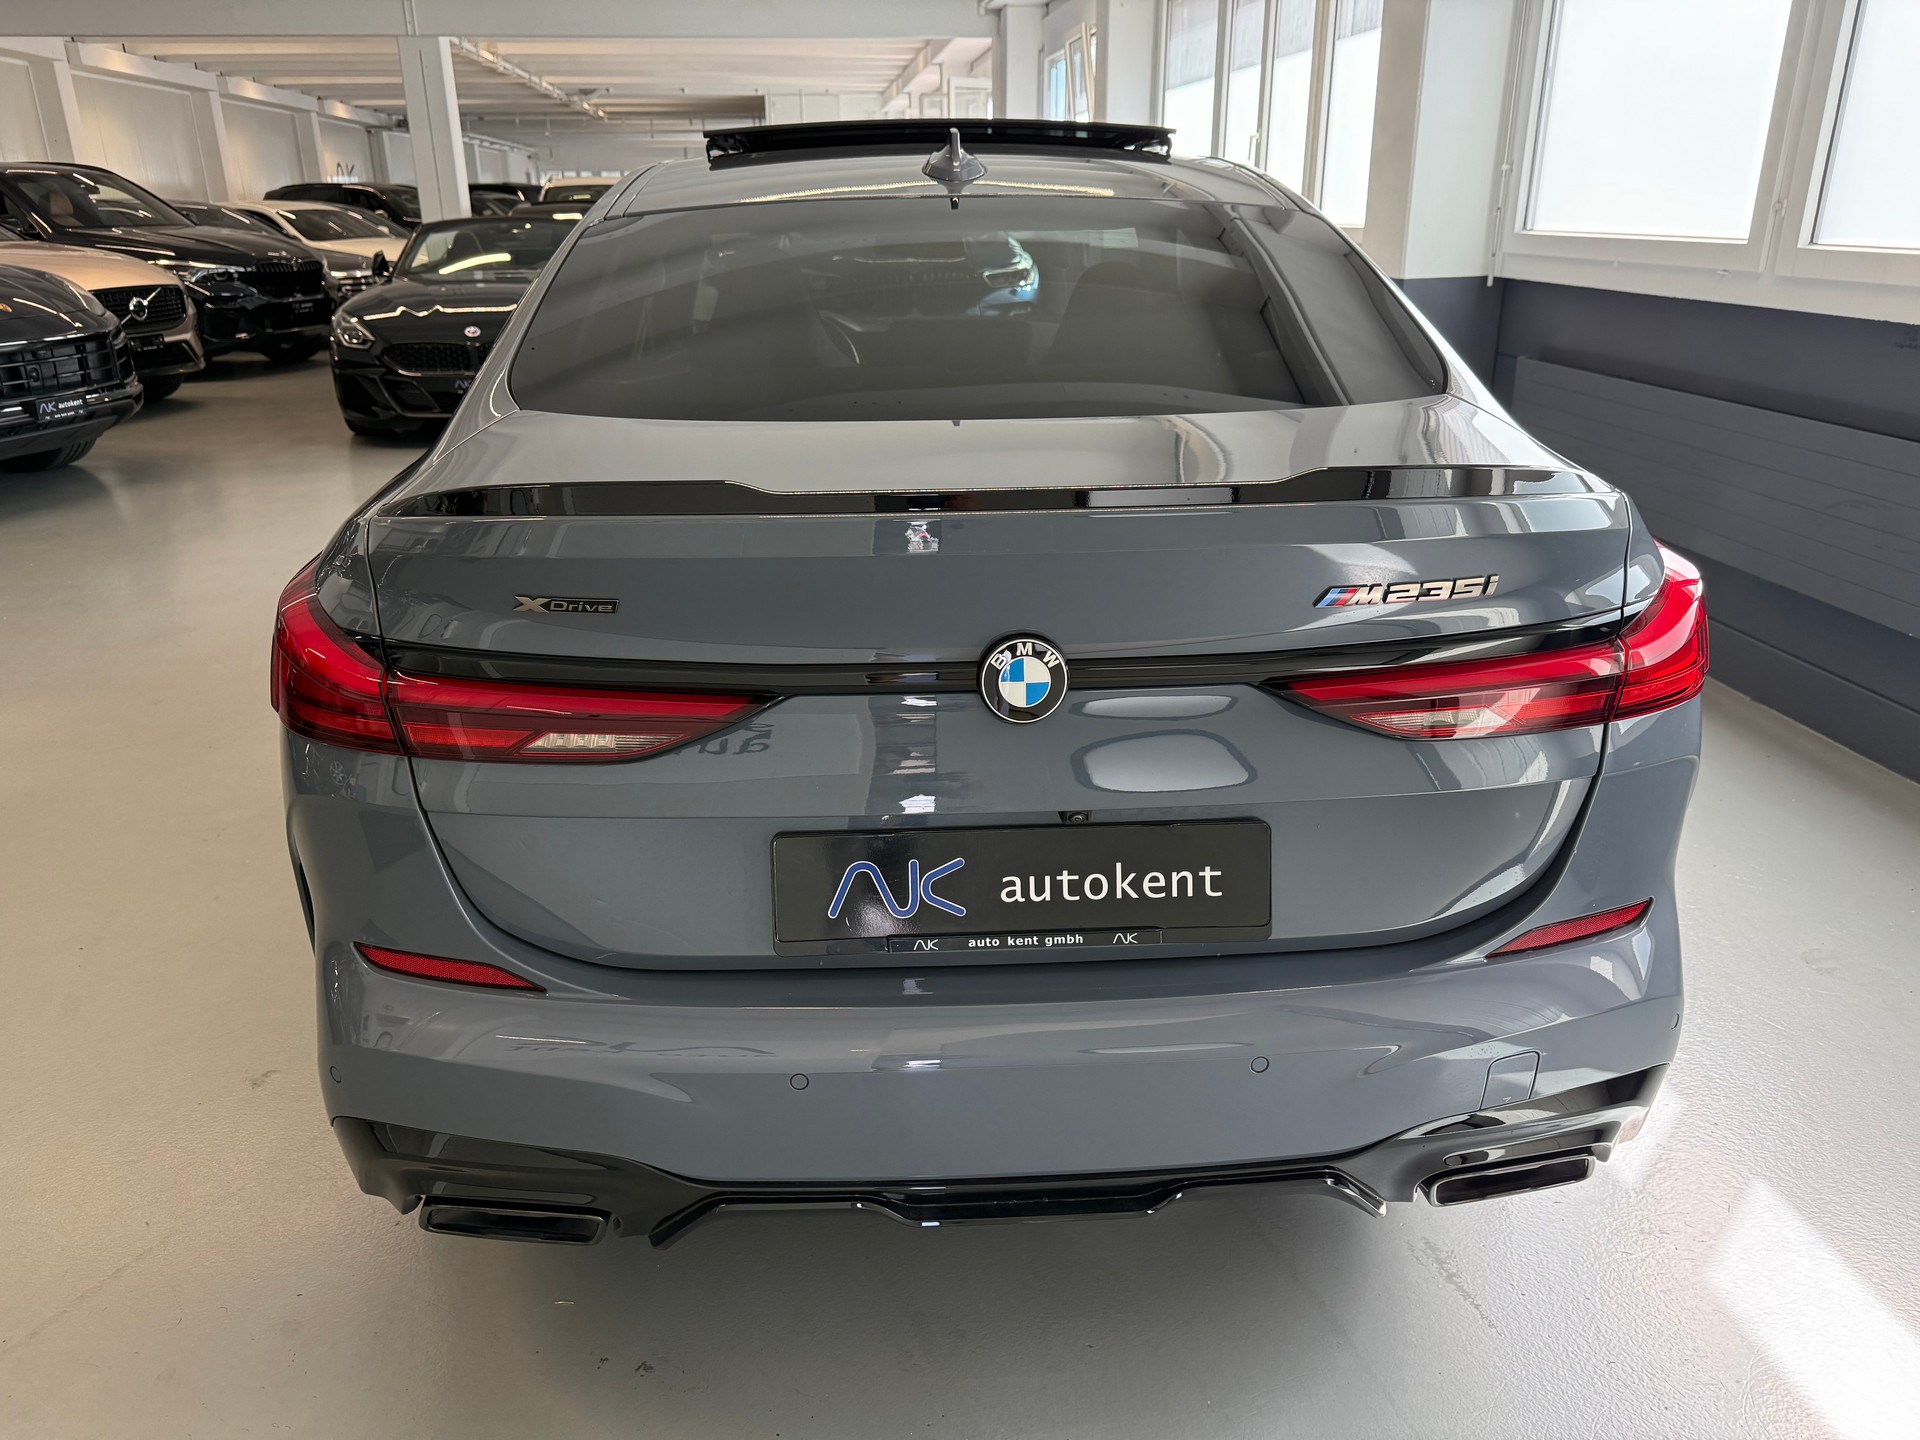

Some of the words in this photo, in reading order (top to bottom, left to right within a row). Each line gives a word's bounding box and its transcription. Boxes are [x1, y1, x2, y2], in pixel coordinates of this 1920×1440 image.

[58, 399, 83, 409] autokent
[1338, 575, 1500, 605] M235i
[990, 642, 1060, 670] BMW
[1000, 862, 1223, 903] autokent
[968, 937, 1000, 948] auto
[1007, 936, 1039, 947] kent
[1044, 934, 1084, 946] gmbh
